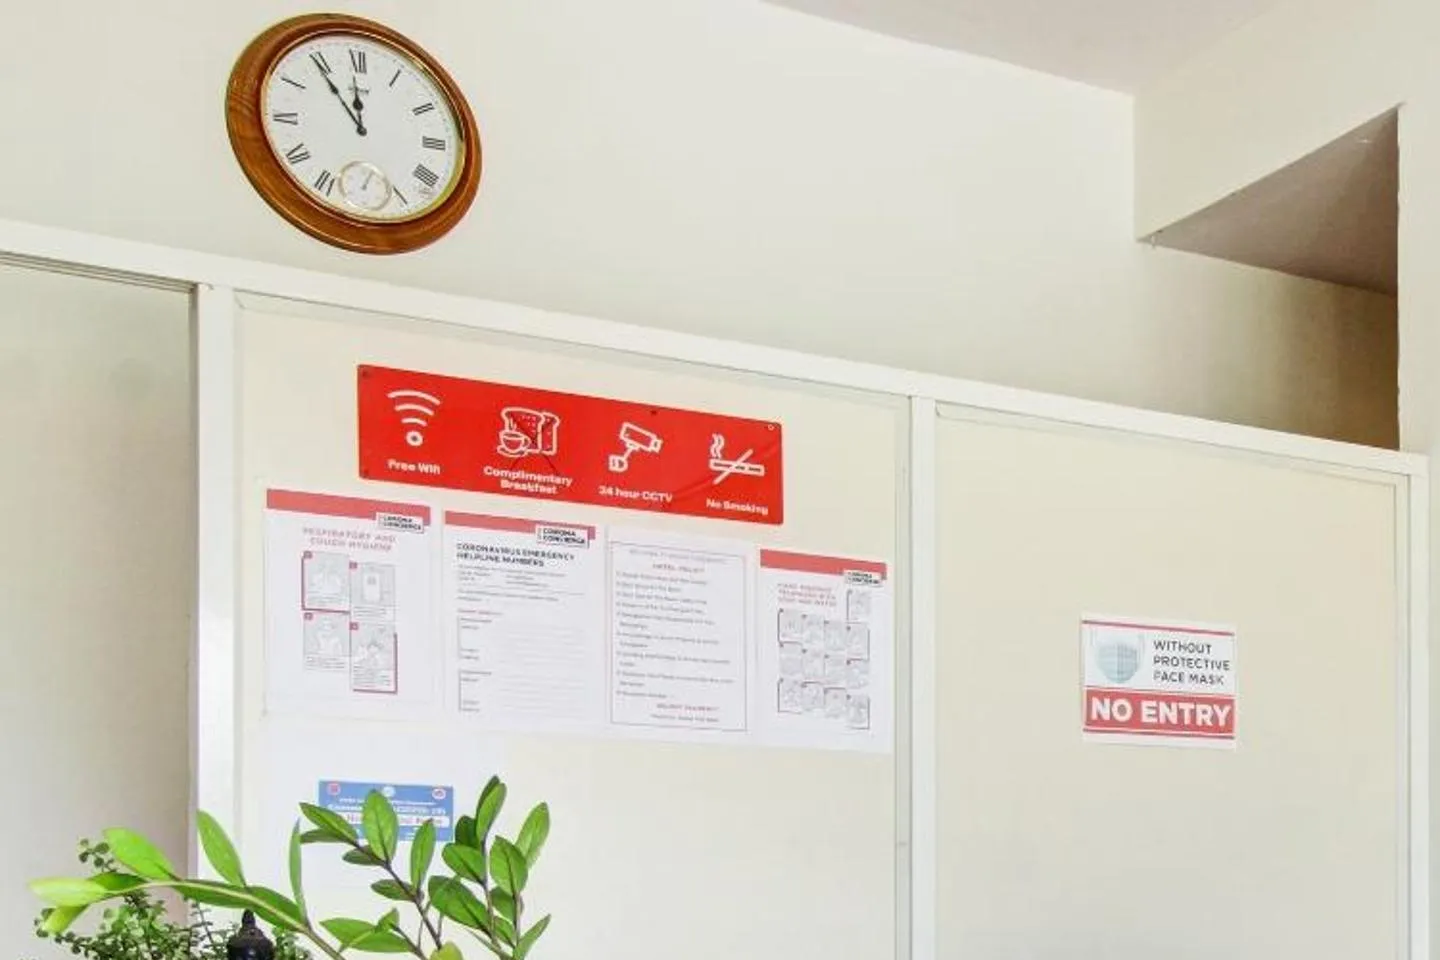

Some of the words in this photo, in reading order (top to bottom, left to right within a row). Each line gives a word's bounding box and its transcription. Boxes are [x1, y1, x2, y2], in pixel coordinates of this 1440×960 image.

[387, 458, 416, 471] Free
[483, 465, 573, 487] Complimentary
[500, 480, 557, 495] Breakfast
[598, 485, 614, 496] 24
[615, 487, 640, 500] hour
[642, 491, 673, 503] CCTV
[706, 498, 722, 509] No
[723, 501, 768, 516] Smoking
[456, 542, 520, 556] CORONAVIRUS
[521, 548, 574, 562] EMERGENCY
[456, 552, 499, 563] HELPLINE
[502, 556, 544, 567] NUMBERS
[1153, 640, 1212, 655] WITHOUT
[1153, 656, 1230, 671] PROTECTIVE
[1153, 672, 1185, 684] FACE
[1188, 674, 1224, 686] MASK
[1091, 697, 1133, 722] NO
[1140, 701, 1231, 727] ENTRY
